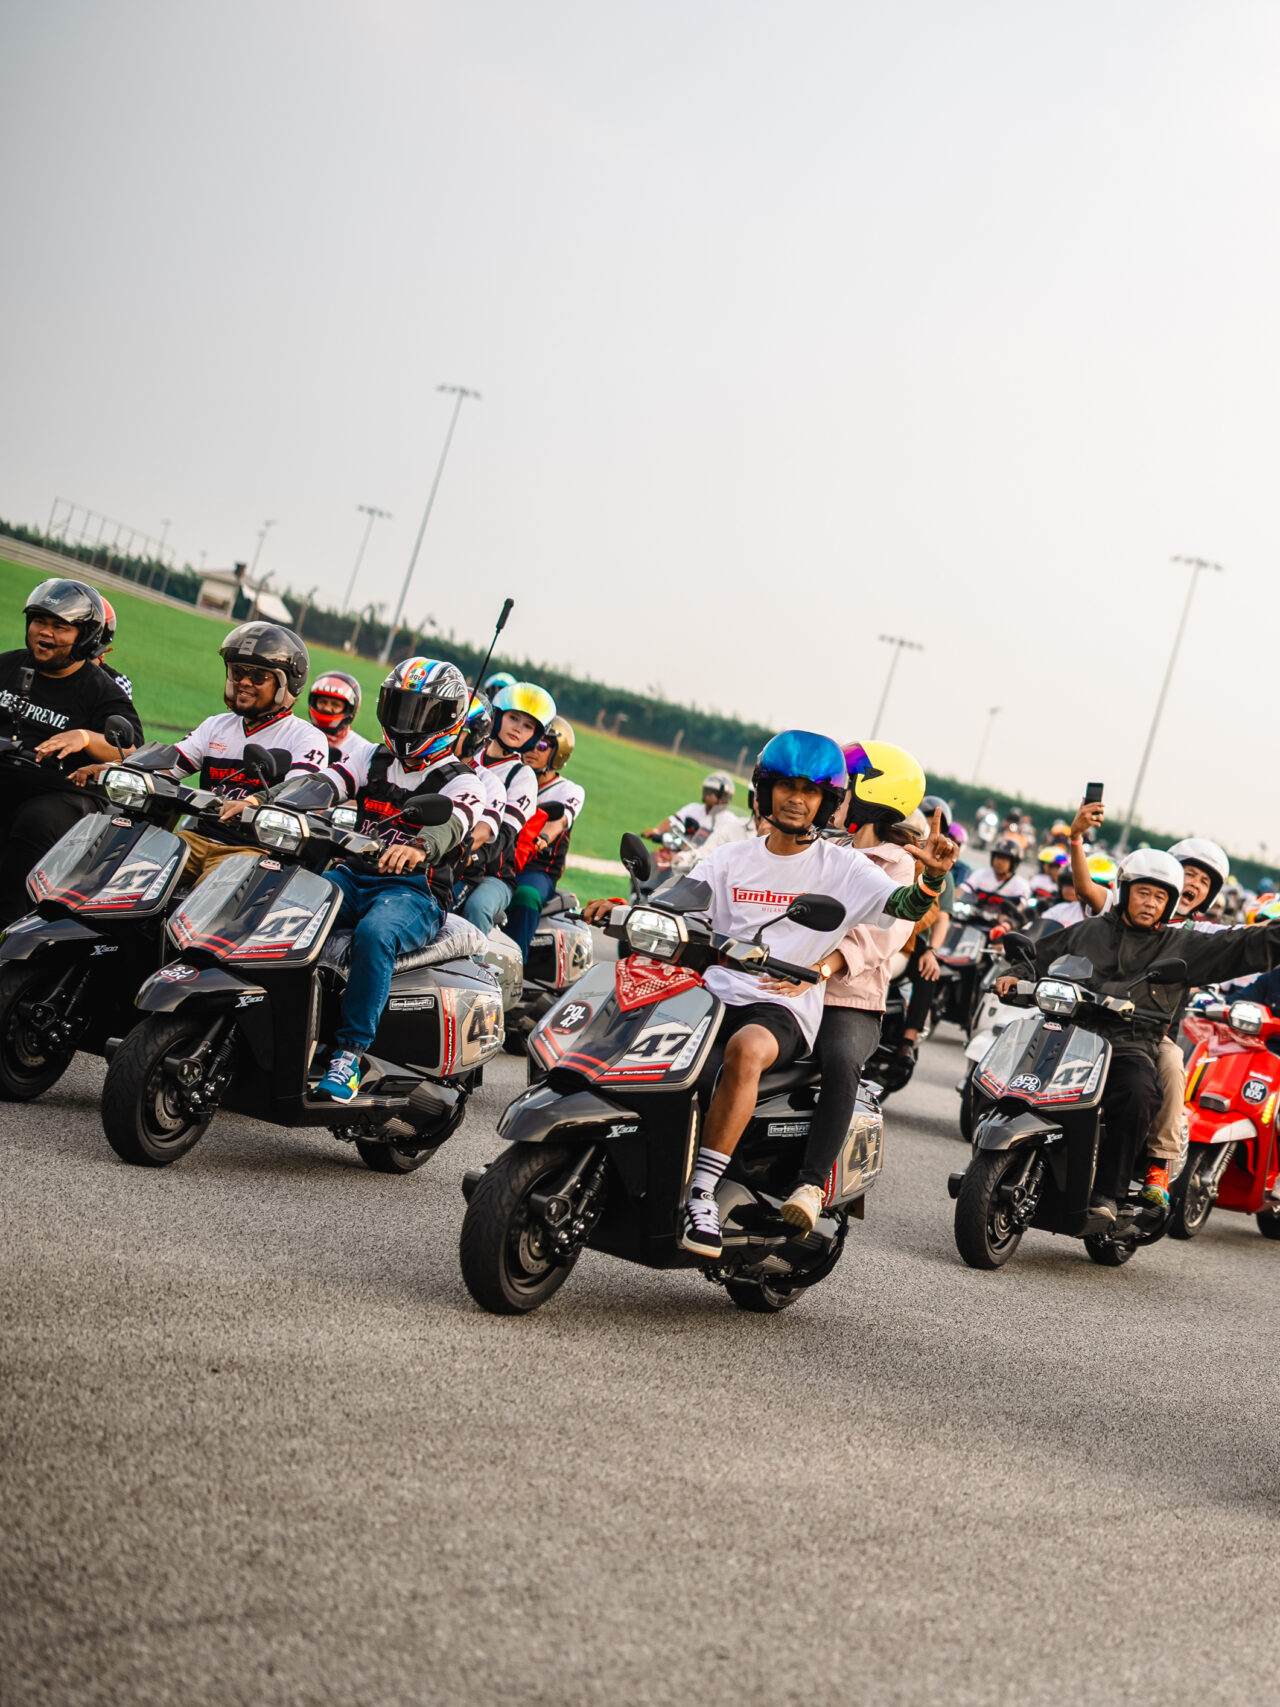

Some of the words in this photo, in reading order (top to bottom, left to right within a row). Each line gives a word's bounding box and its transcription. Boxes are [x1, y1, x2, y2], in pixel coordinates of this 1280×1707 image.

[304, 749, 325, 765] 47
[516, 794, 531, 811] 47
[109, 870, 156, 890] 47
[255, 916, 308, 938] 47
[235, 995, 264, 1008] X300
[630, 1033, 692, 1057] 47
[1014, 1075, 1039, 1086] APD
[1052, 1066, 1093, 1086] 47
[605, 1124, 639, 1138] X300
